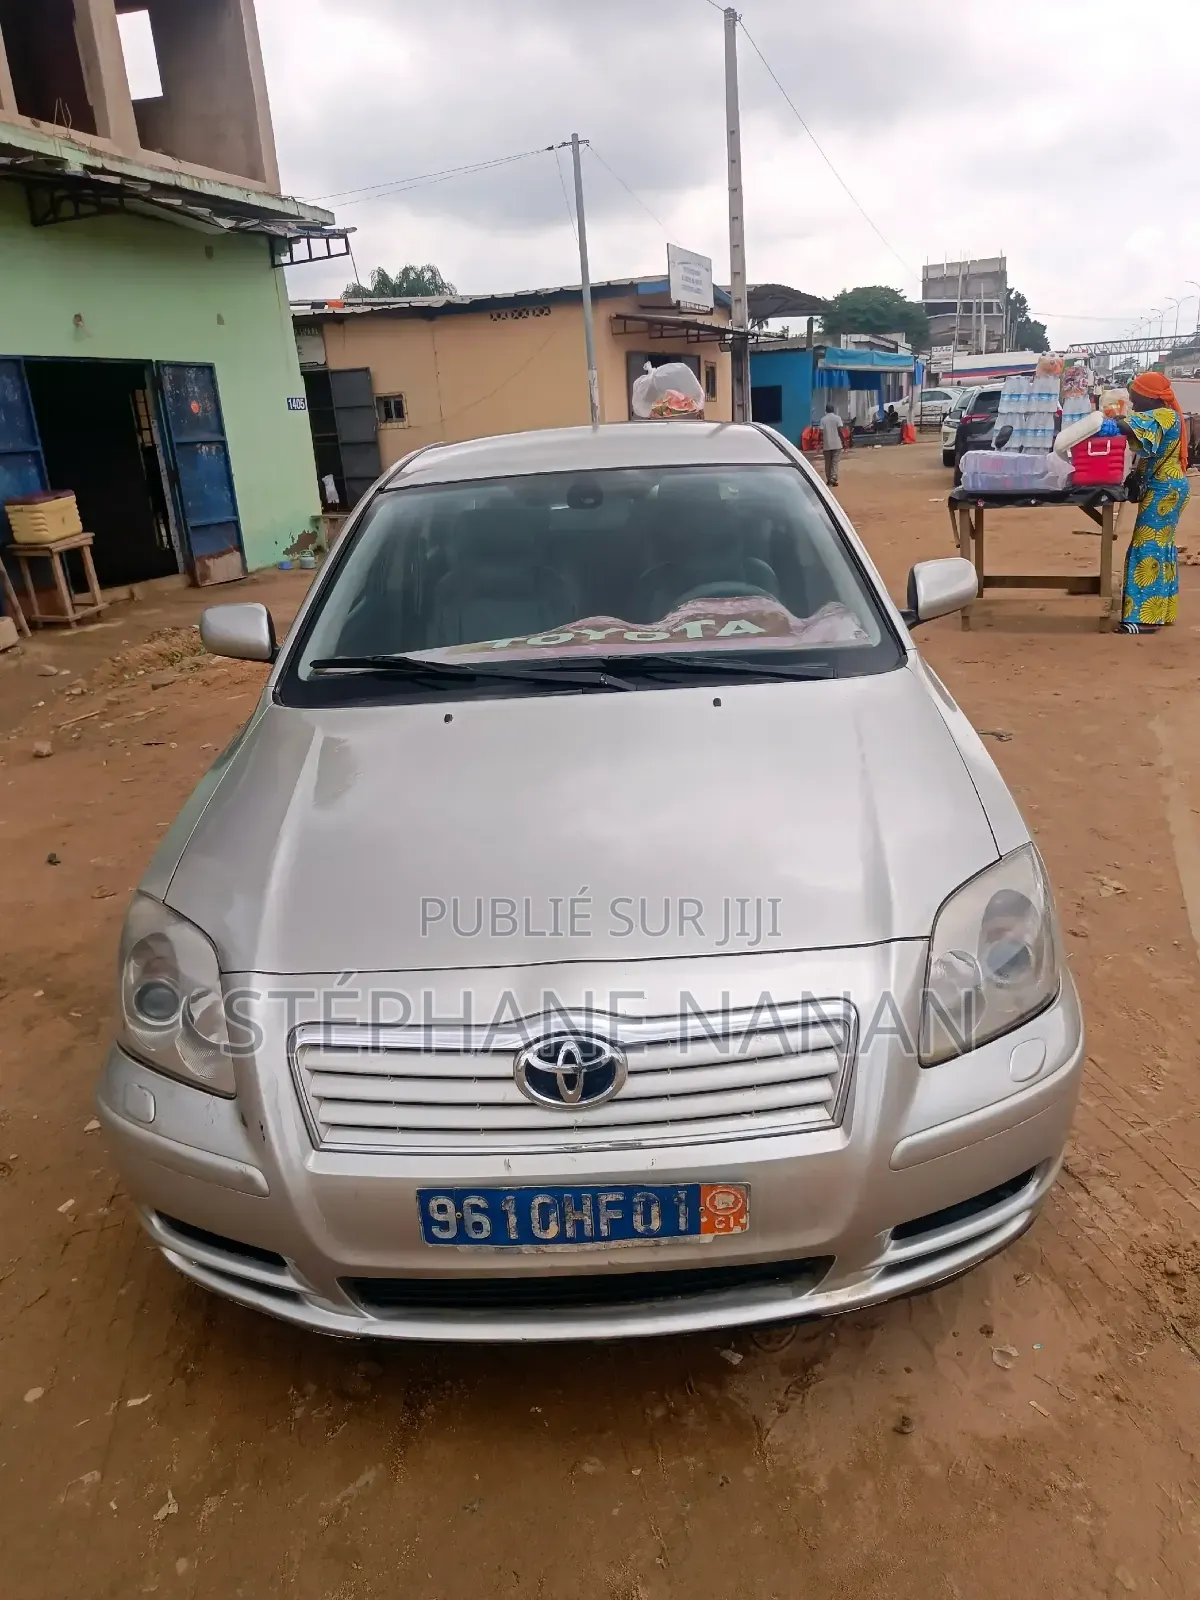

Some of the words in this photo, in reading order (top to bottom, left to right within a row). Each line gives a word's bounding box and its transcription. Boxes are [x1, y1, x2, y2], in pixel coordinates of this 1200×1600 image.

[288, 398, 305, 410] 1405
[491, 619, 767, 649] TOYOTA
[427, 1190, 689, 1240] 9610HF01
